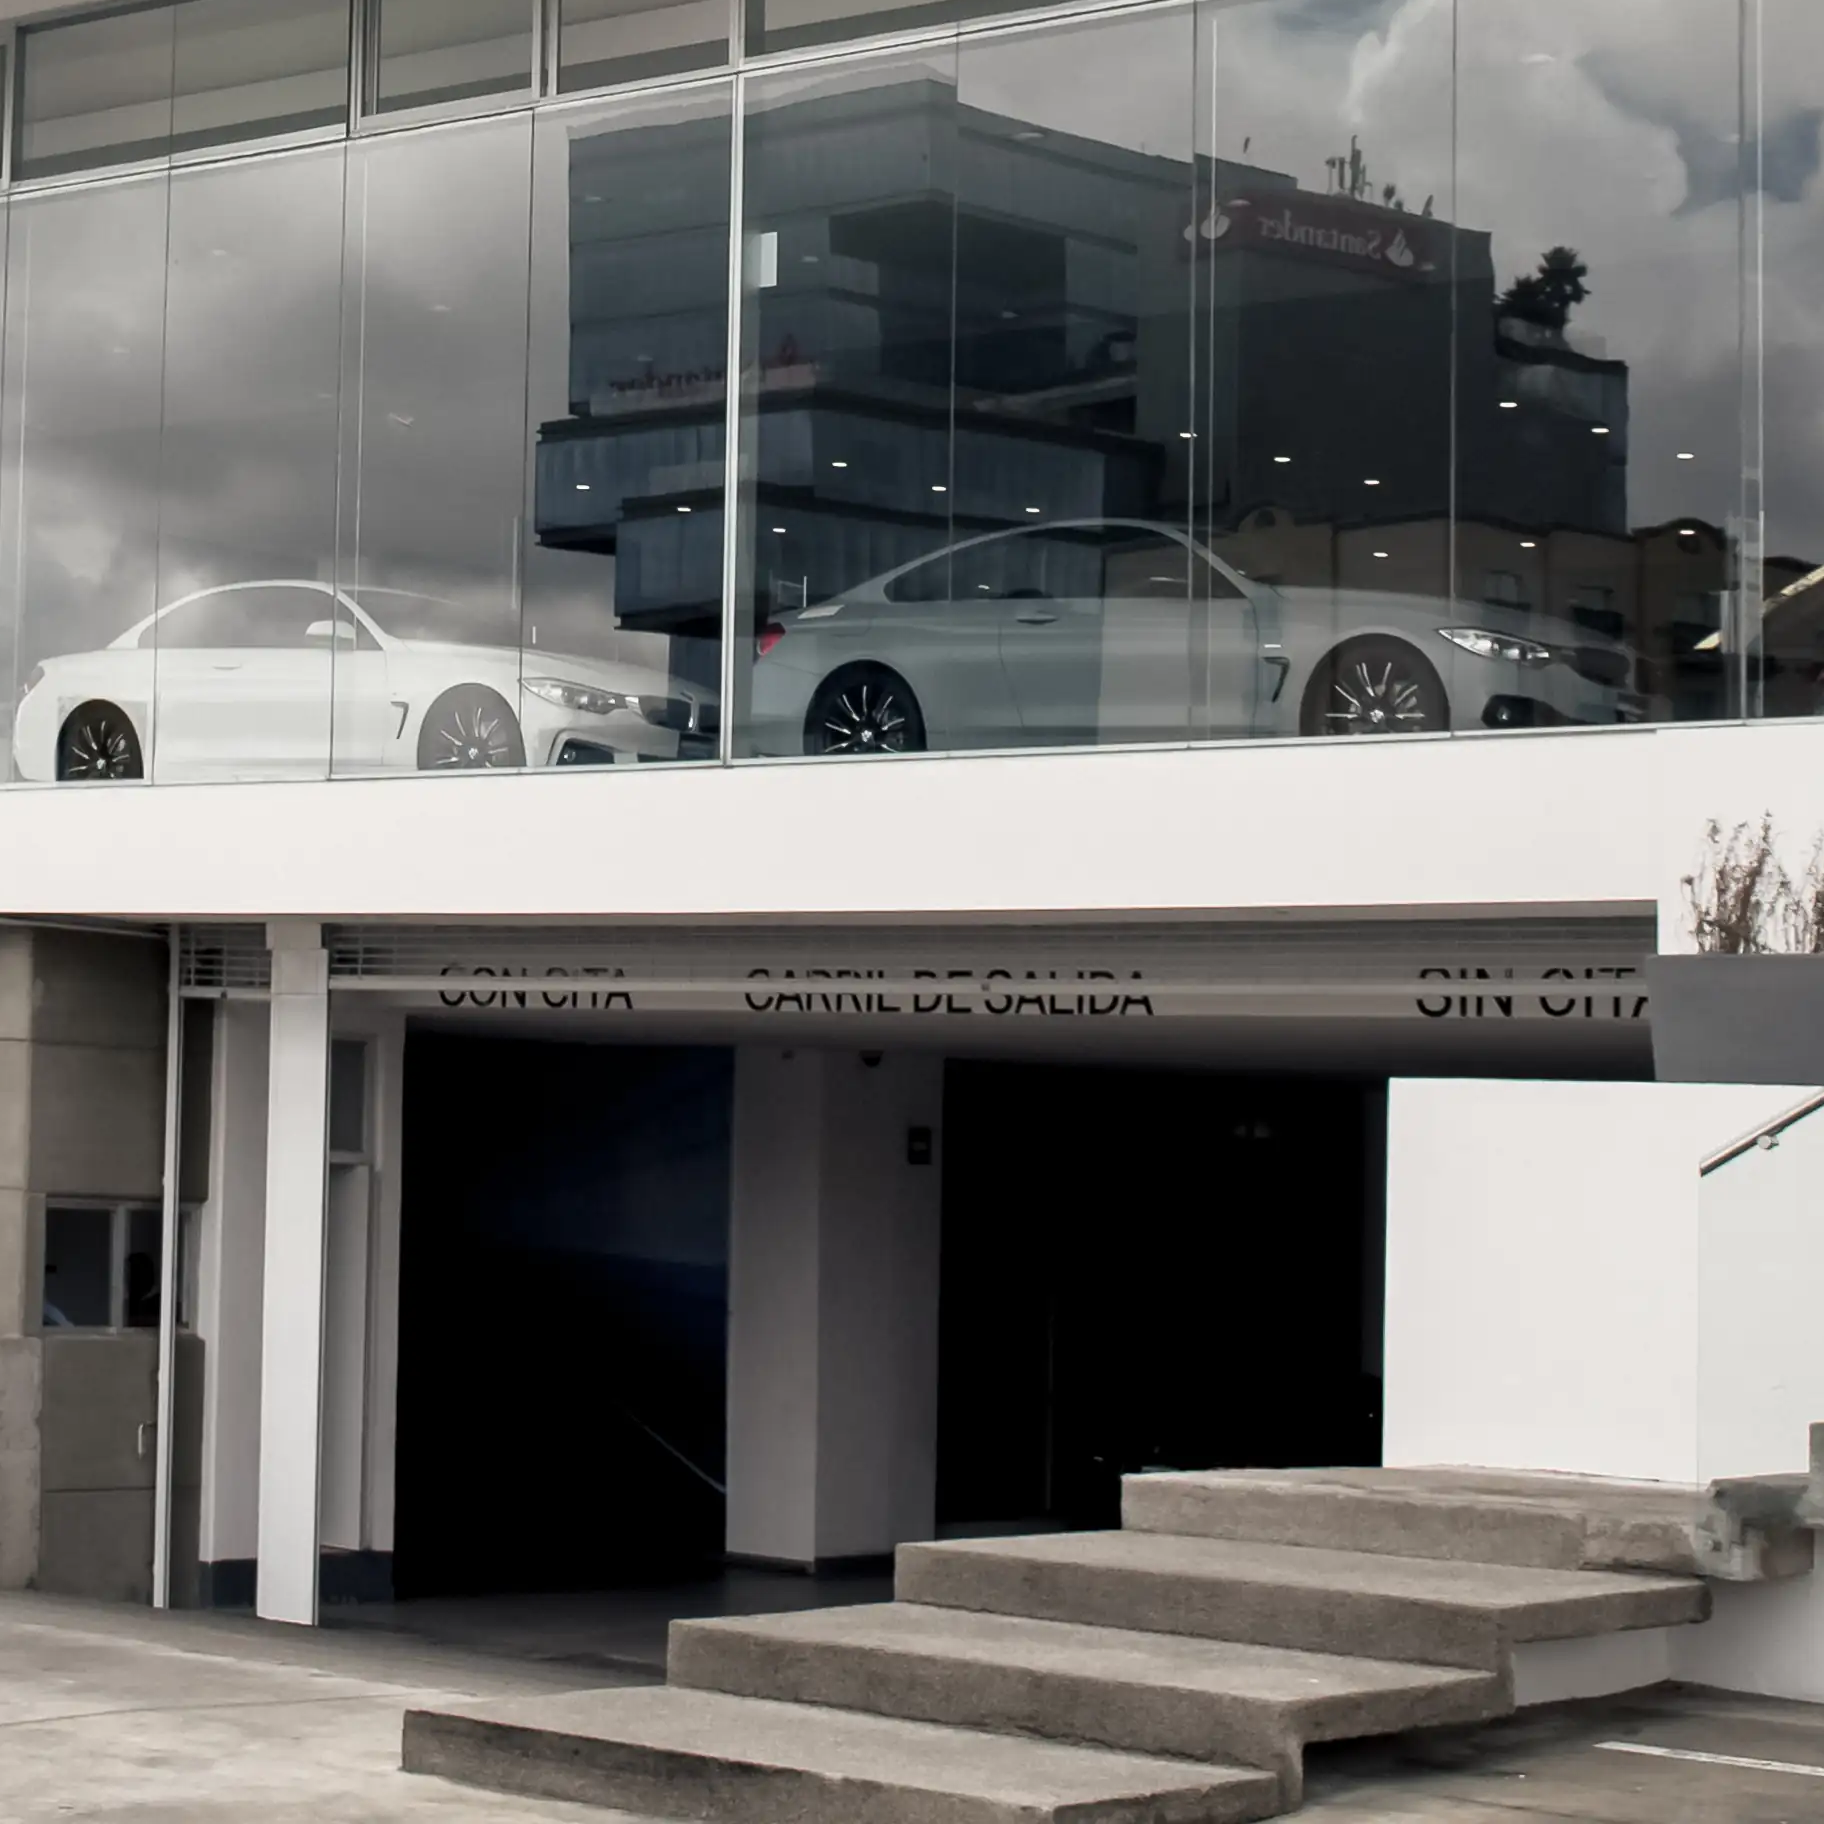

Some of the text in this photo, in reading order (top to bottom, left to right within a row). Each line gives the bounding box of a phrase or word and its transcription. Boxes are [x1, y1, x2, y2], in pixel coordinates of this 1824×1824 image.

[438, 965, 634, 1010] CON CITA
[744, 968, 1155, 1016] CARRIL DE SALIDA
[1415, 967, 1513, 1018] SIN
